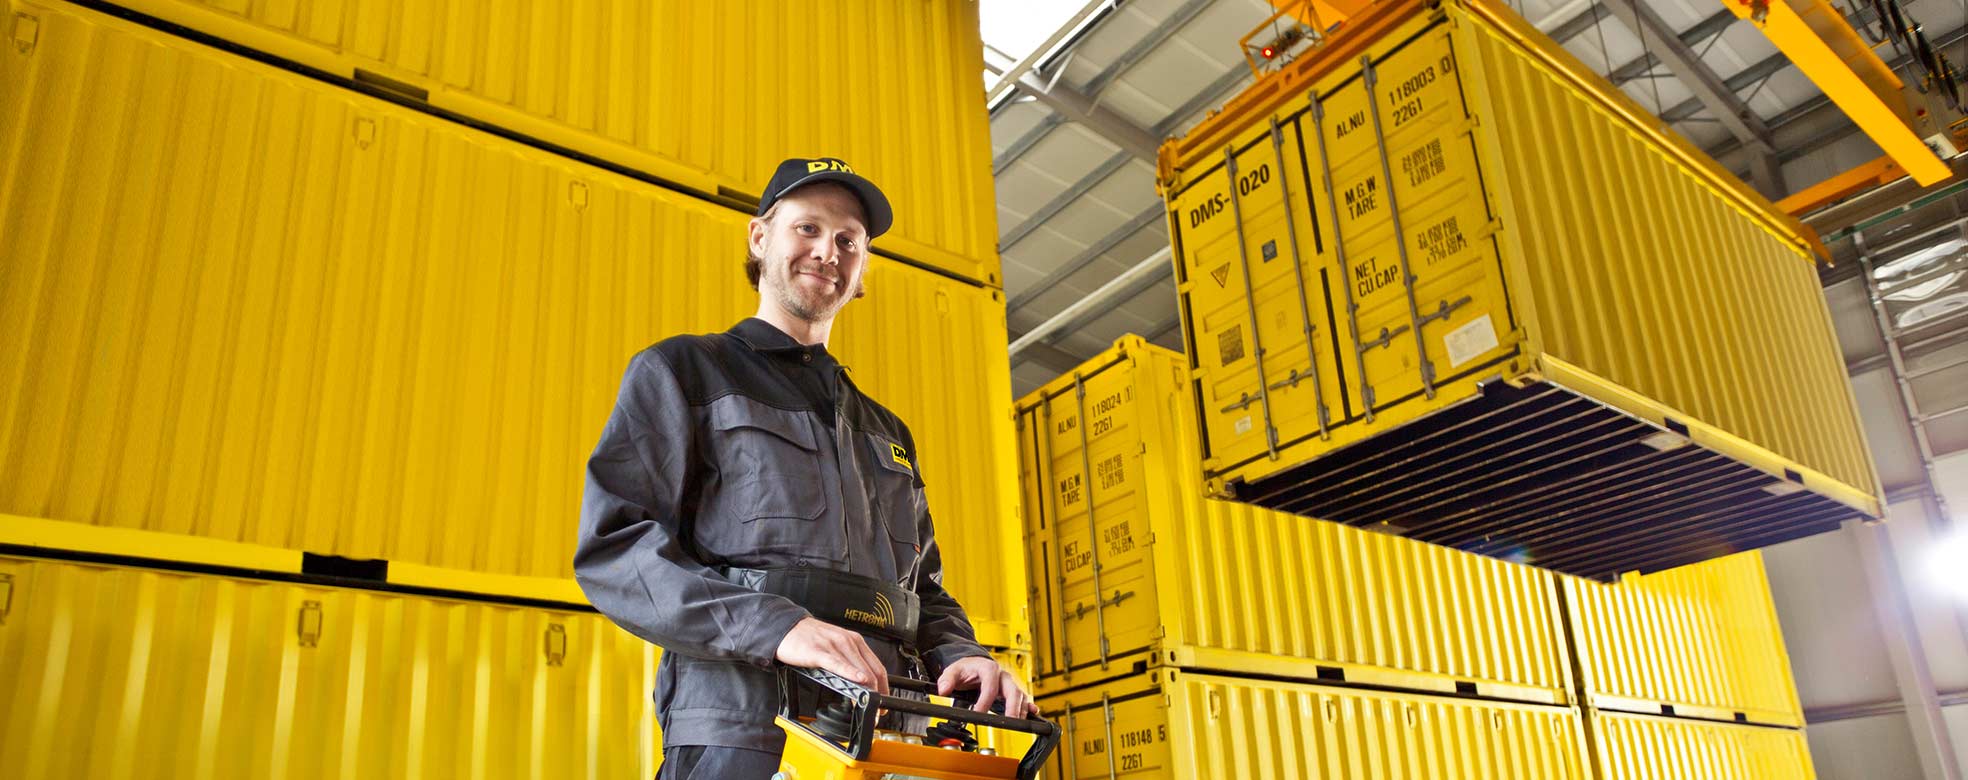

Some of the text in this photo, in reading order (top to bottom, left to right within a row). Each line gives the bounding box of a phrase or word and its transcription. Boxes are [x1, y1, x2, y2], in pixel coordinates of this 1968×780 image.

[1336, 110, 1365, 140] ALNU
[1389, 66, 1436, 106] 118003
[1349, 194, 1378, 220] TARE
[1355, 257, 1377, 280] NET
[1058, 415, 1077, 436] ALNU
[1092, 391, 1121, 418] 118024
[1062, 488, 1080, 508] TARE
[1064, 540, 1078, 558] NET
[1084, 724, 1166, 756] ALNU 118148 5
